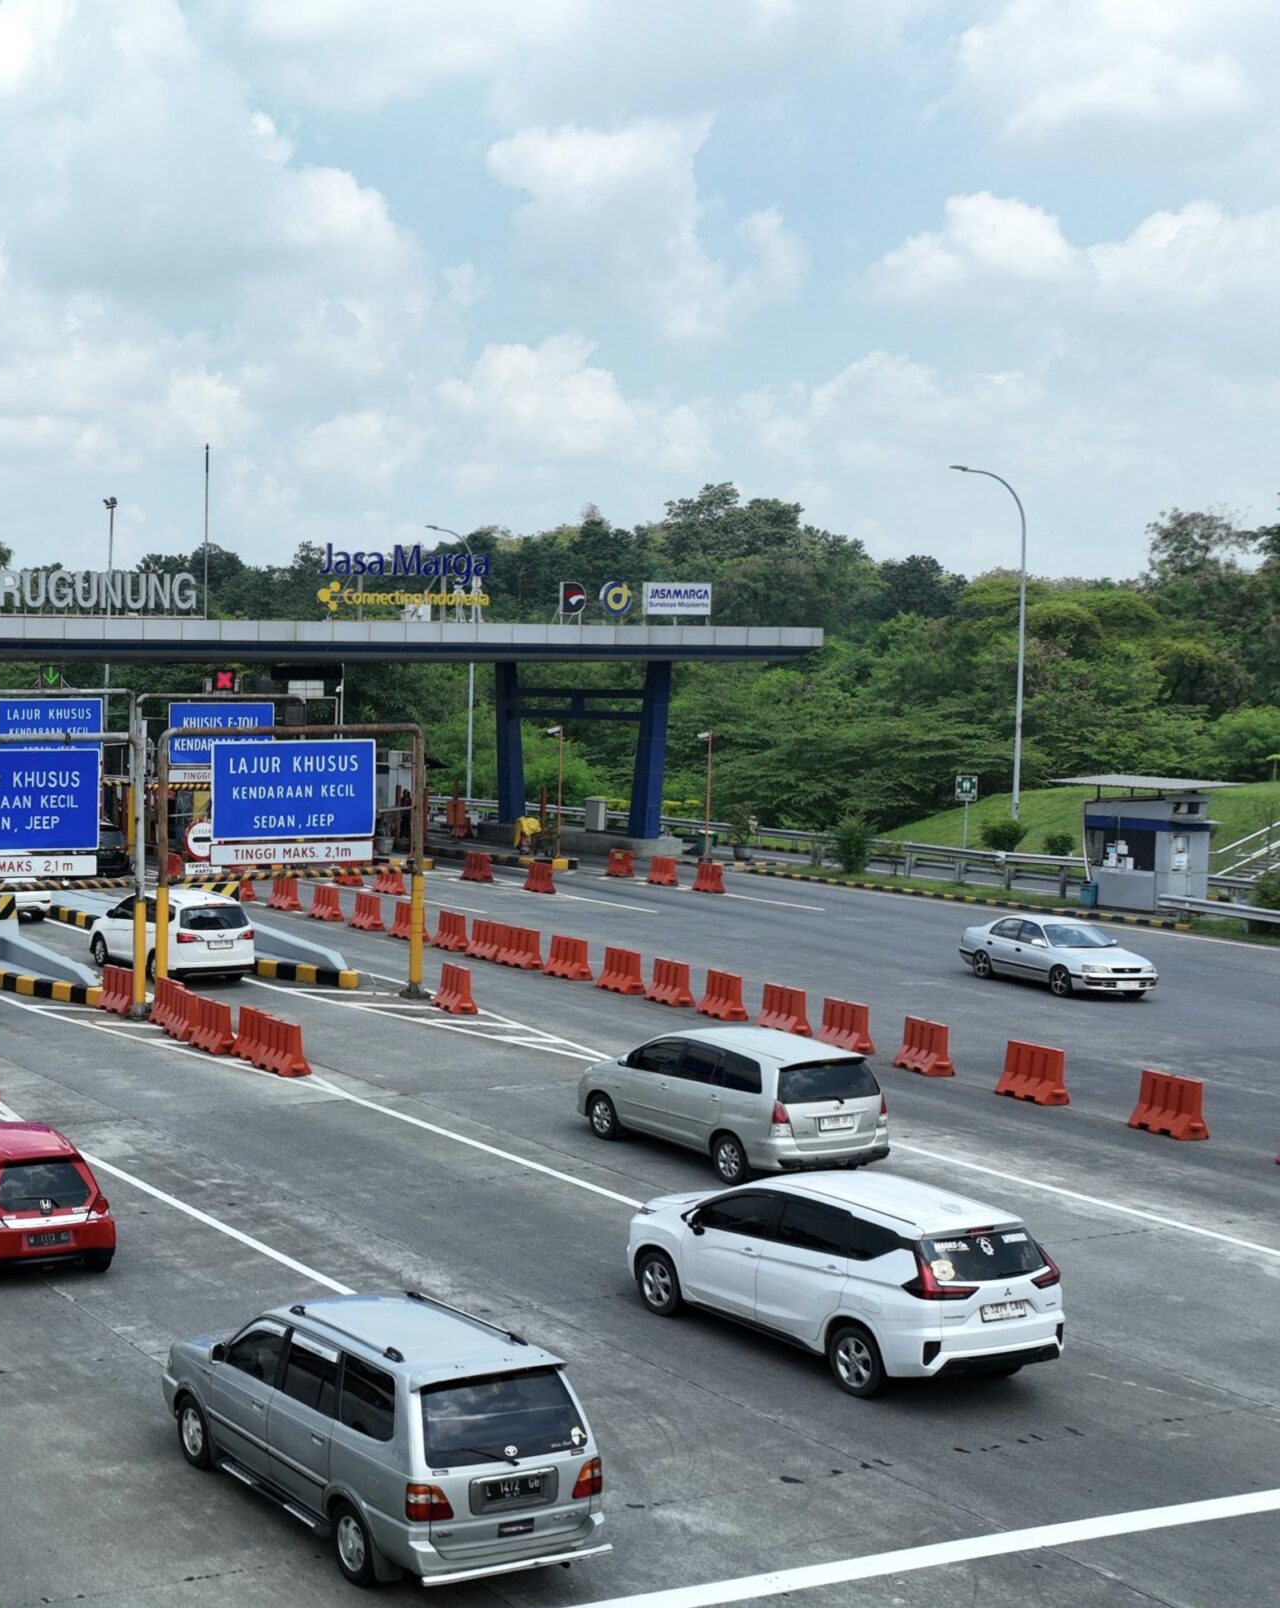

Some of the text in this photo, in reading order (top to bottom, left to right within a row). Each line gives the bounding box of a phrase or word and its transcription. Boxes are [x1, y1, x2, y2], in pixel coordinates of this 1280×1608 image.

[319, 542, 491, 585] Jasa Marga
[342, 588, 424, 608] Connecting
[649, 588, 709, 599] JASAMARGA
[7, 708, 92, 720] LAJUR KHUSUS
[183, 717, 222, 728] KHUSUS
[229, 755, 359, 774] LAJUR KHUSUS
[13, 771, 80, 788] KHUSUS
[183, 772, 211, 780] TINGGI
[232, 784, 355, 800] KENDARAAN KECIL
[40, 795, 78, 809] KECIL
[24, 816, 60, 830] JEEP
[305, 814, 335, 827] JEEP
[233, 849, 276, 860] TINGGI
[282, 848, 319, 859] MAKS.
[486, 1486, 491, 1497] L
